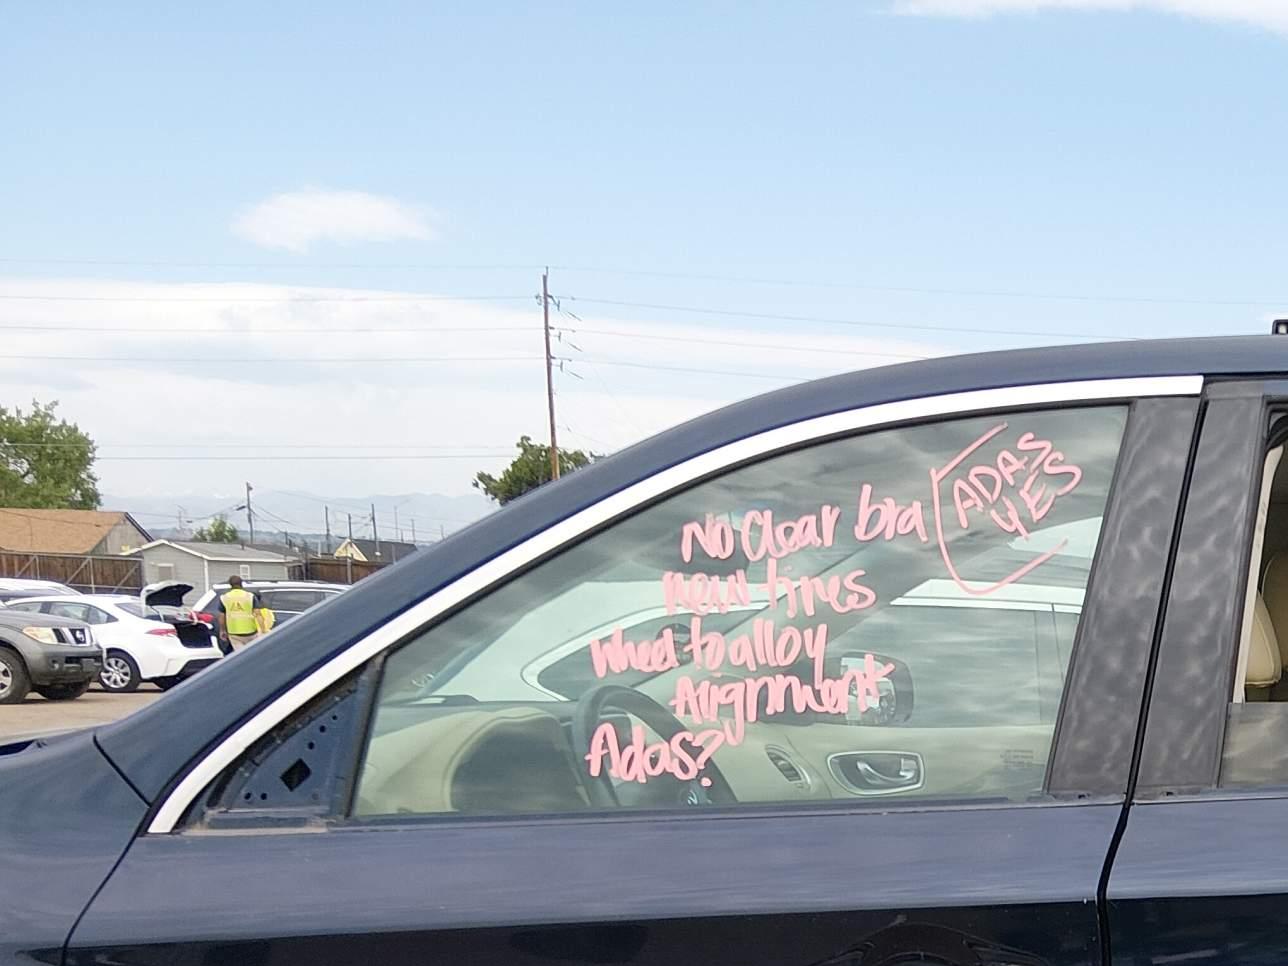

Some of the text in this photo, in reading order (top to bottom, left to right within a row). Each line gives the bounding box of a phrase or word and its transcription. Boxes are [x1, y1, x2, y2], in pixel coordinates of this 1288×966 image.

[952, 432, 1052, 529] ADAS
[990, 454, 1083, 541] YES
[728, 618, 829, 692] alloy
